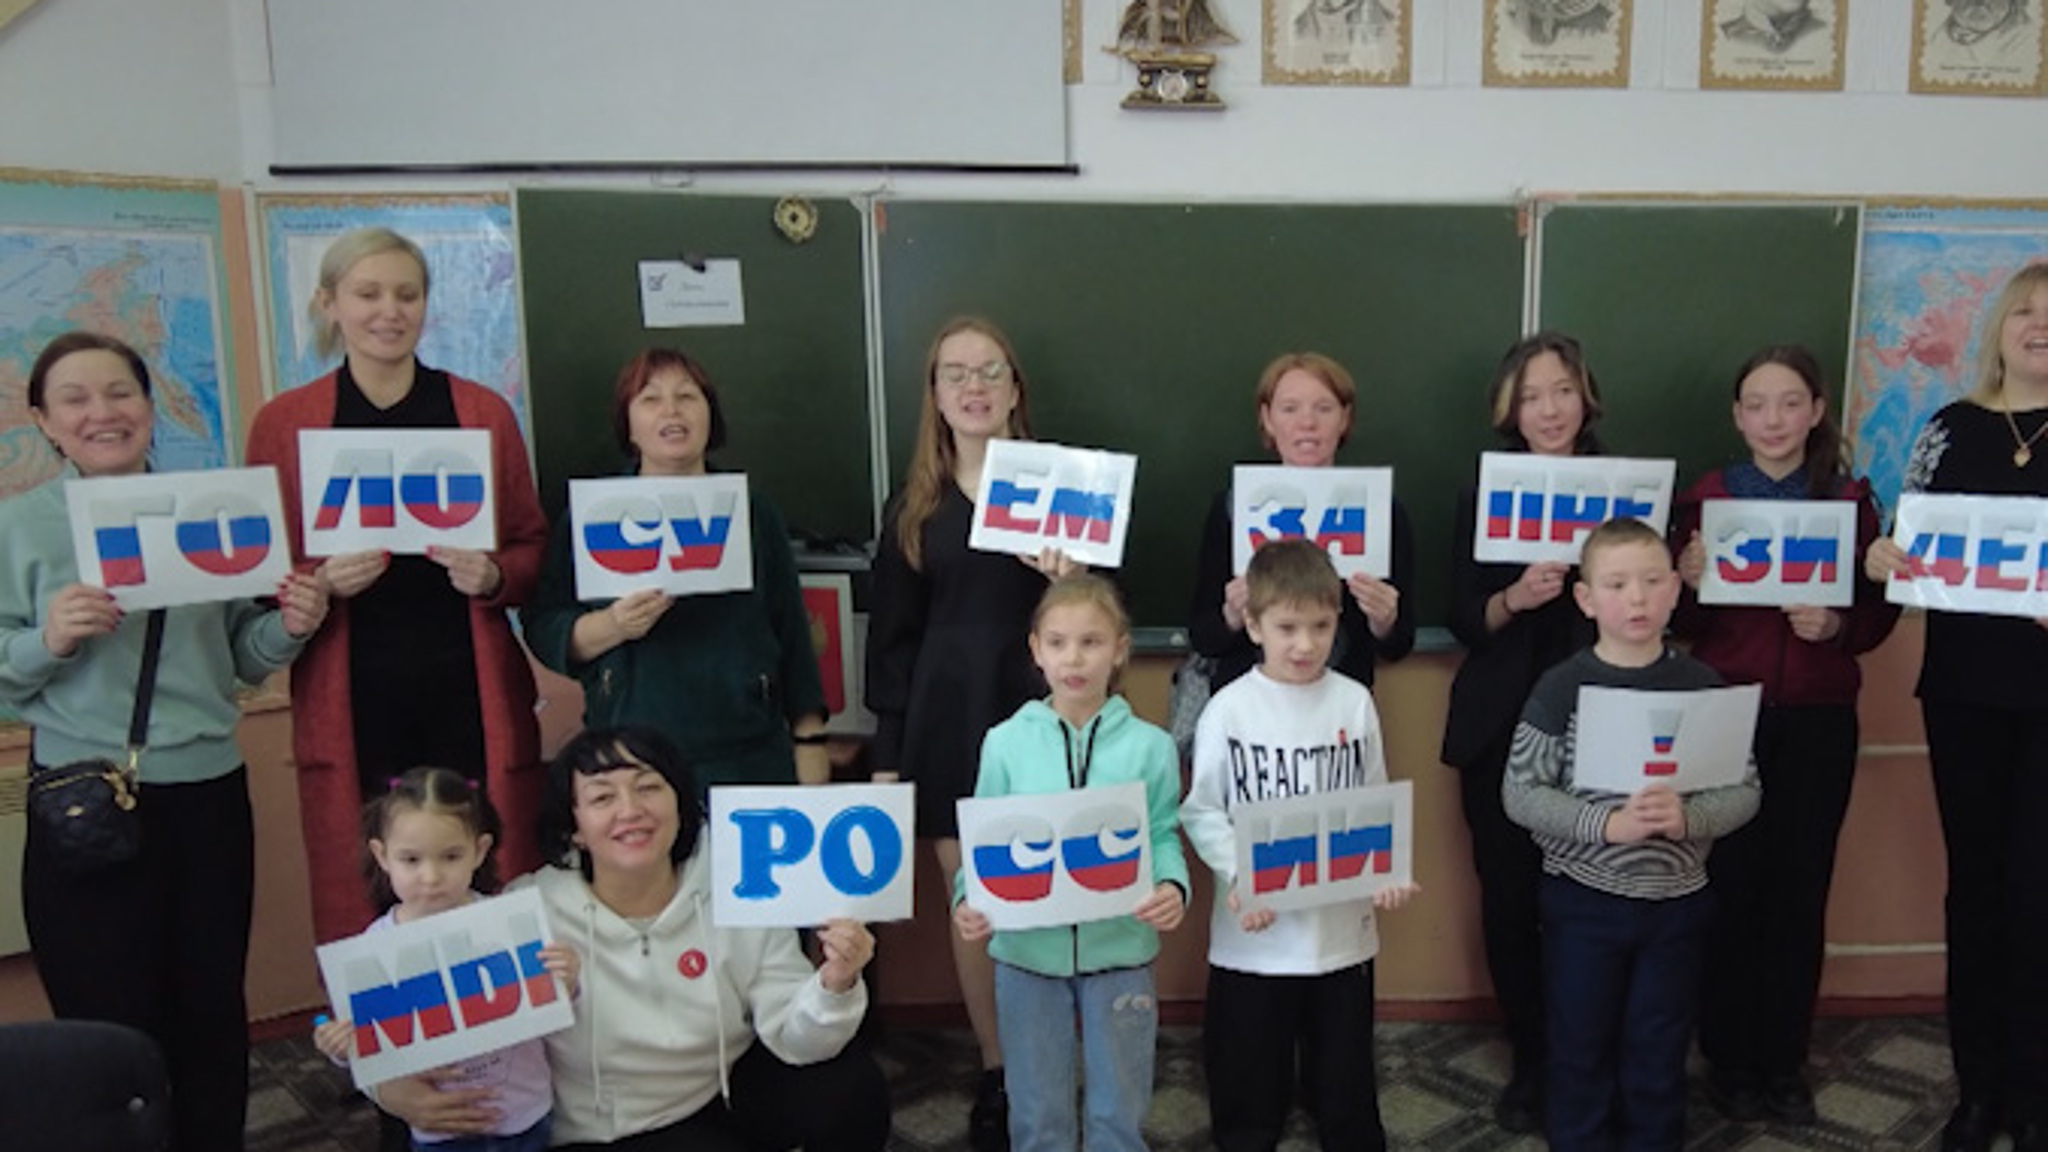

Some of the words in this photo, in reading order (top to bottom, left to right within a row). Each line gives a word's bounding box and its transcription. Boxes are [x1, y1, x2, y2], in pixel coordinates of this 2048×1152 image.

[313, 446, 486, 529] ЛО
[983, 466, 1118, 543] ЕМ
[1248, 482, 1368, 555] ЗА
[91, 491, 272, 587] ГО
[583, 490, 737, 574] СУ
[1717, 514, 1840, 583] ЗИ
[1893, 510, 2048, 592] ДЕ
[1227, 733, 1371, 803] REACTION
[729, 805, 902, 899] РО
[972, 802, 1142, 903] СС
[1251, 800, 1394, 894] ИИ
[343, 908, 558, 1059] МЫ
